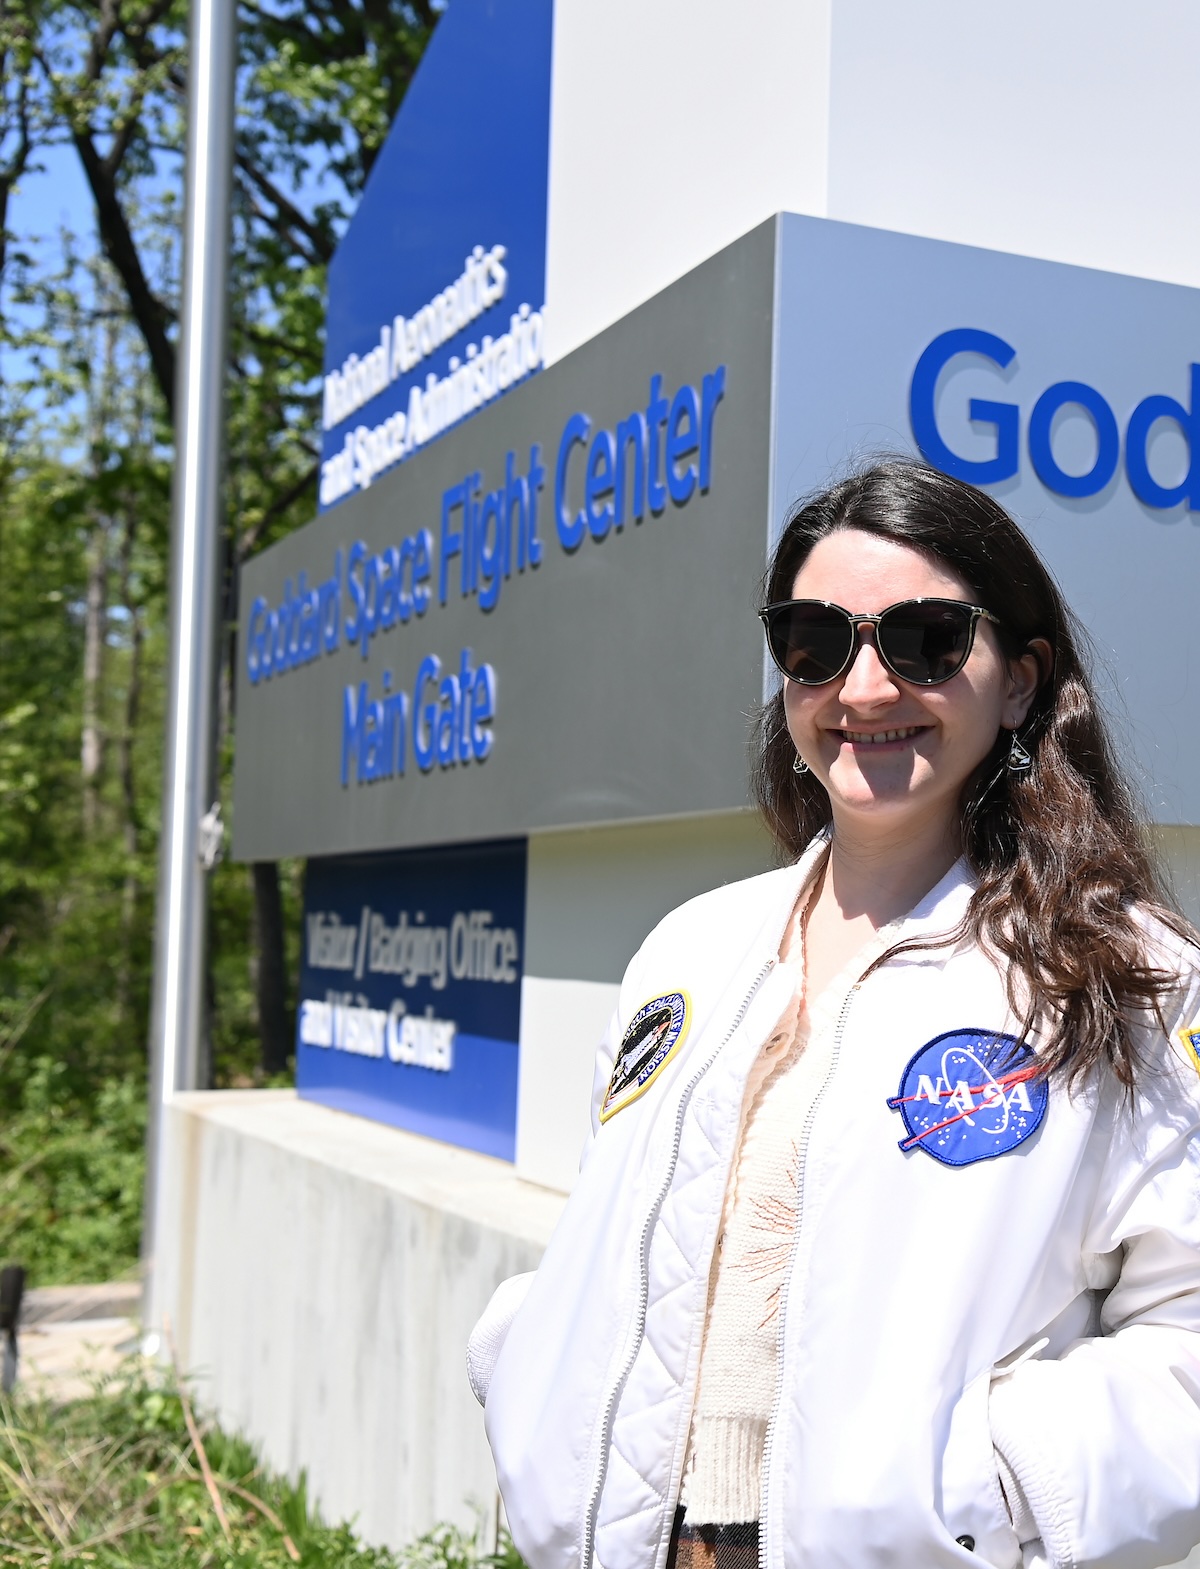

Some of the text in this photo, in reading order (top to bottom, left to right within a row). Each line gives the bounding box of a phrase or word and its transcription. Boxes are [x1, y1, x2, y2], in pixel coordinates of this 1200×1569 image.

[323, 244, 507, 430] National Aeronautics
[319, 302, 547, 505] and Space Administratio
[248, 365, 727, 682] Goddard Space Flight Center
[342, 648, 495, 784] Main Gate
[306, 906, 518, 990] Visitor / Badging Office
[301, 991, 456, 1072] and Visitor Center
[639, 1031, 679, 1081] MISSION
[914, 1074, 1034, 1112] NASA
